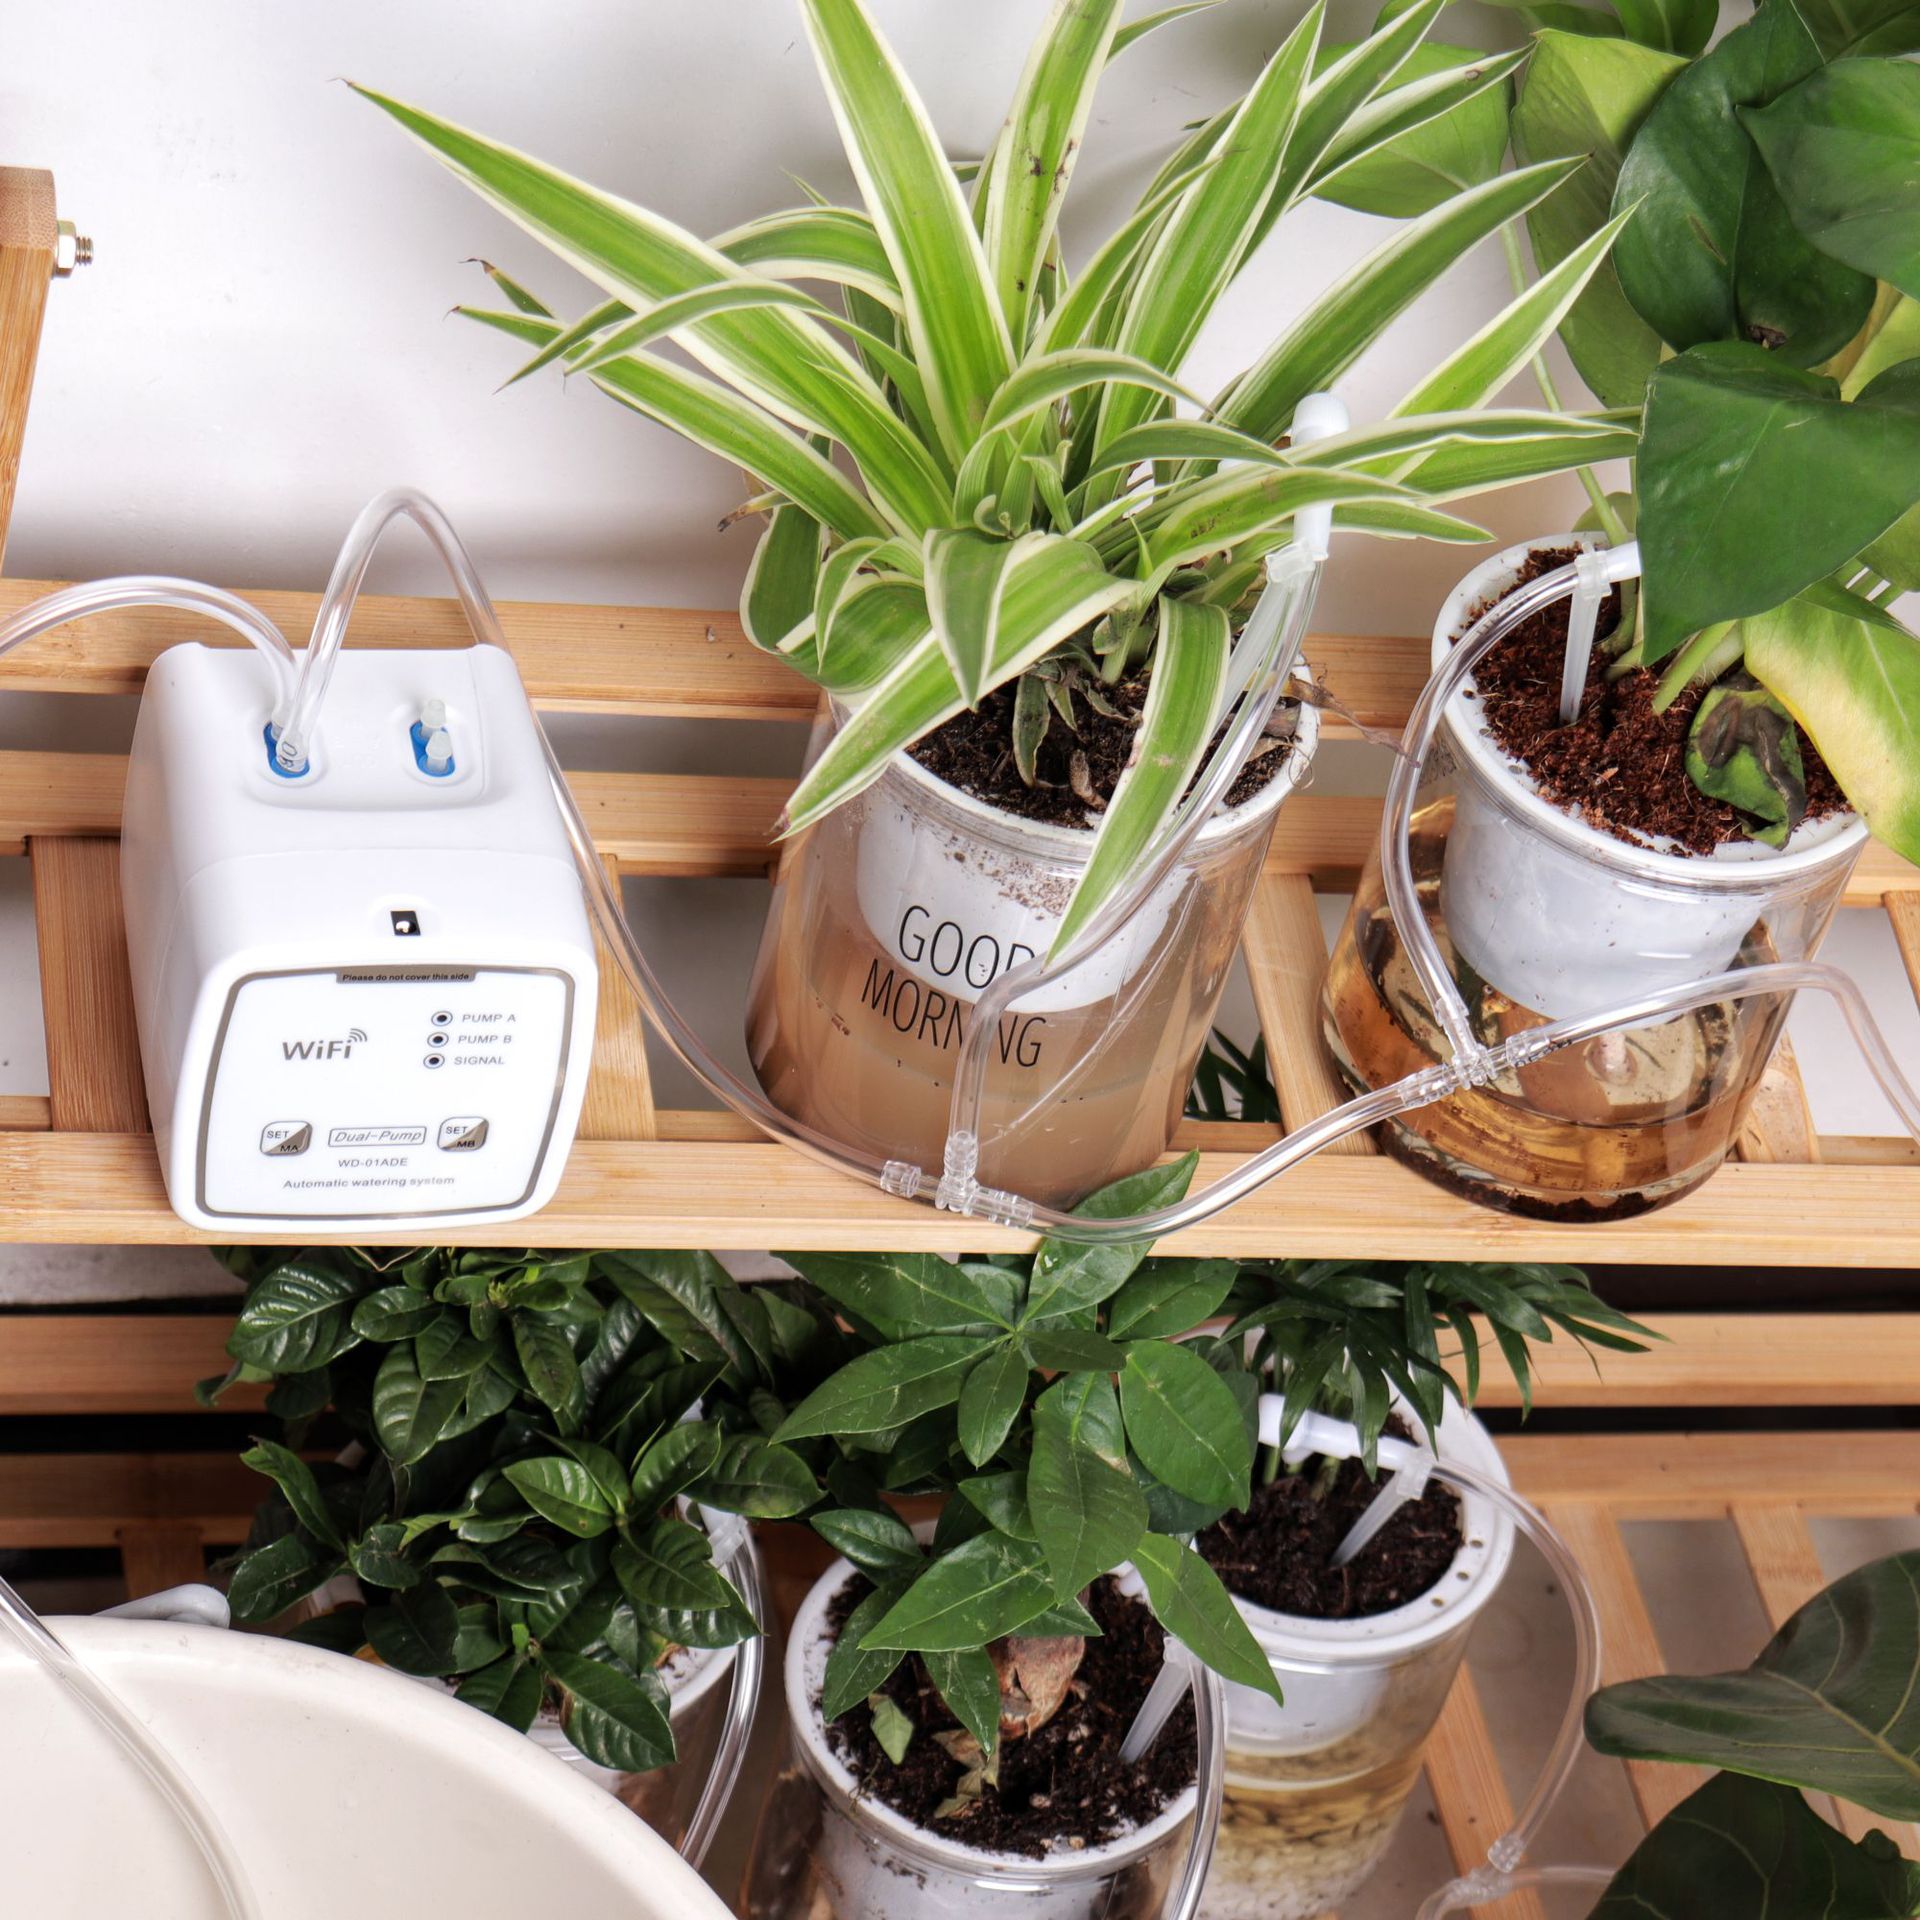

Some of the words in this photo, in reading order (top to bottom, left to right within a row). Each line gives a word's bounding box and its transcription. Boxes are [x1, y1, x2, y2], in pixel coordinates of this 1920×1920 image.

[861, 958, 1047, 1067] MORNNG
[462, 1014, 503, 1023] PUMP
[507, 1014, 517, 1022] A
[458, 1035, 499, 1044] PUMP
[503, 1034, 512, 1043] B
[282, 1040, 352, 1060] WiFi
[454, 1056, 505, 1065] SIGNAL
[267, 1131, 290, 1139] SET
[446, 1126, 468, 1135] SET
[334, 1130, 422, 1143] Dual-Pump
[456, 1140, 475, 1148] MB
[338, 1157, 408, 1168] WD-01ADE
[283, 1178, 348, 1189] Automatic
[352, 1177, 406, 1188] watering
[410, 1177, 455, 1187] system
